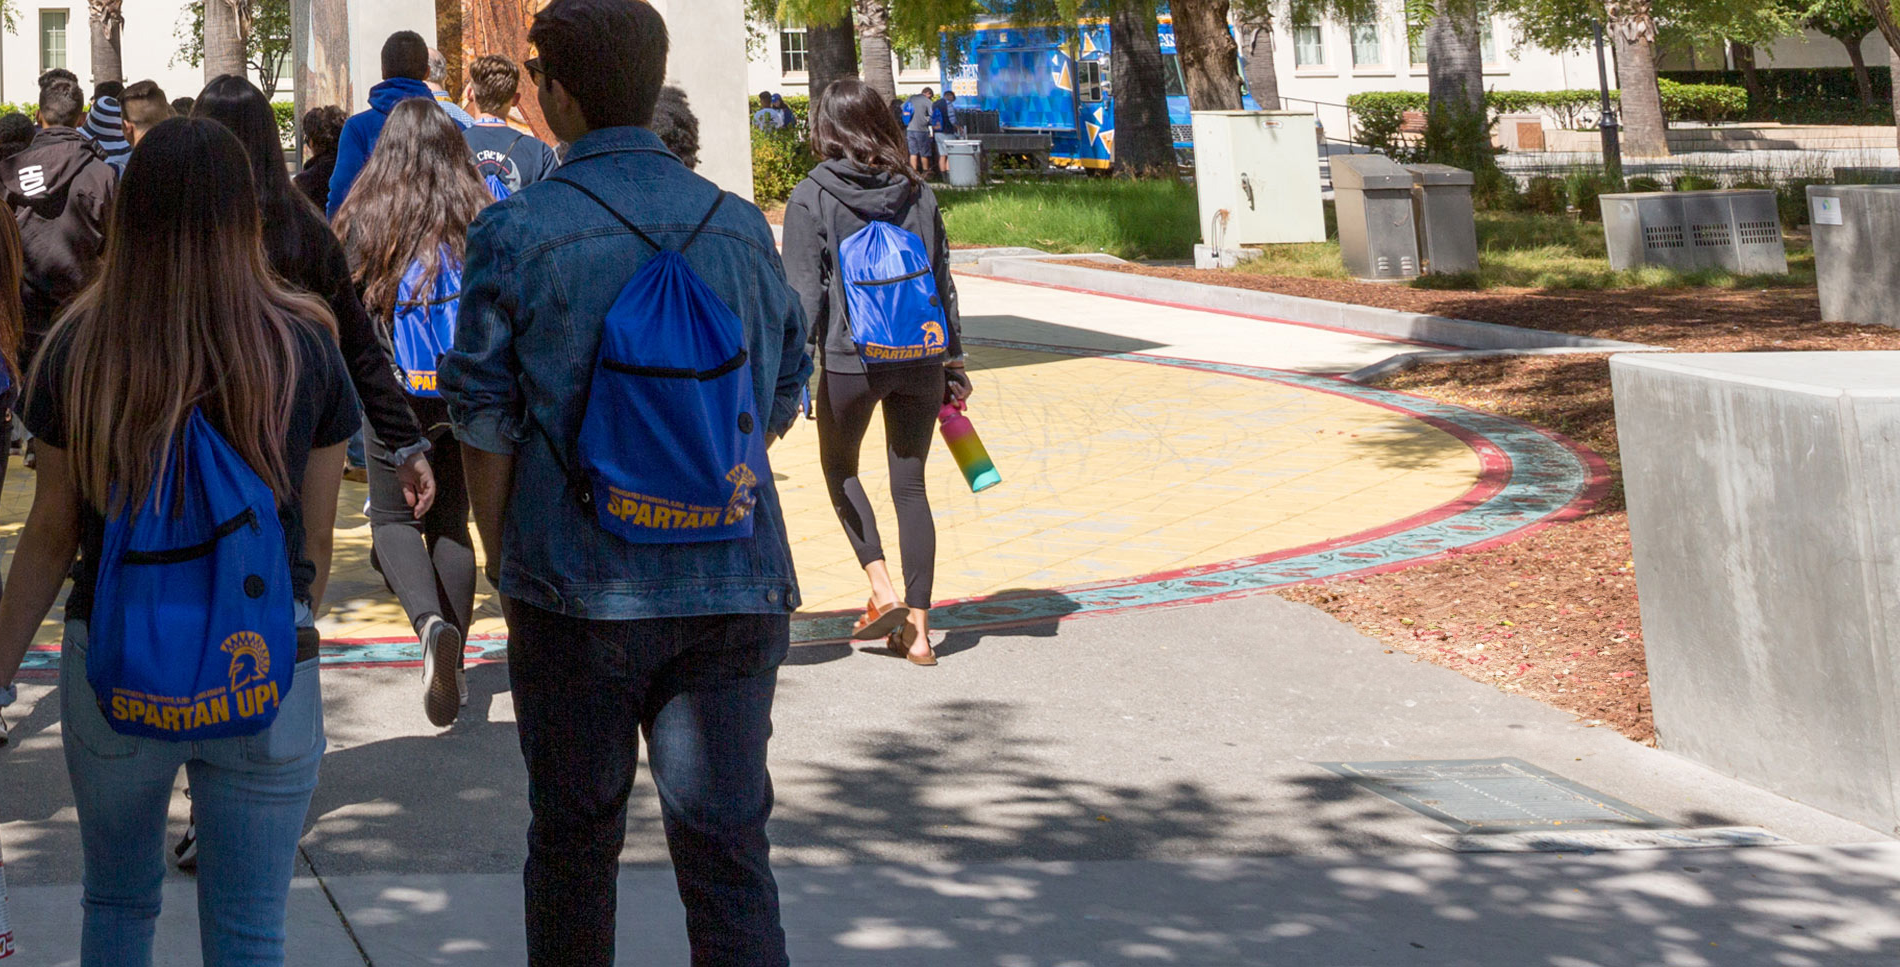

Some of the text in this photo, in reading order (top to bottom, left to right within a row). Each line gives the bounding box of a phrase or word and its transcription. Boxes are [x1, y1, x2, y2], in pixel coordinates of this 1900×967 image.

[477, 150, 505, 163] CREW
[866, 346, 923, 360] SPARTAN
[607, 494, 721, 530] SPARTAN
[112, 694, 230, 732] SPARTAN
[236, 680, 279, 718] UP!
